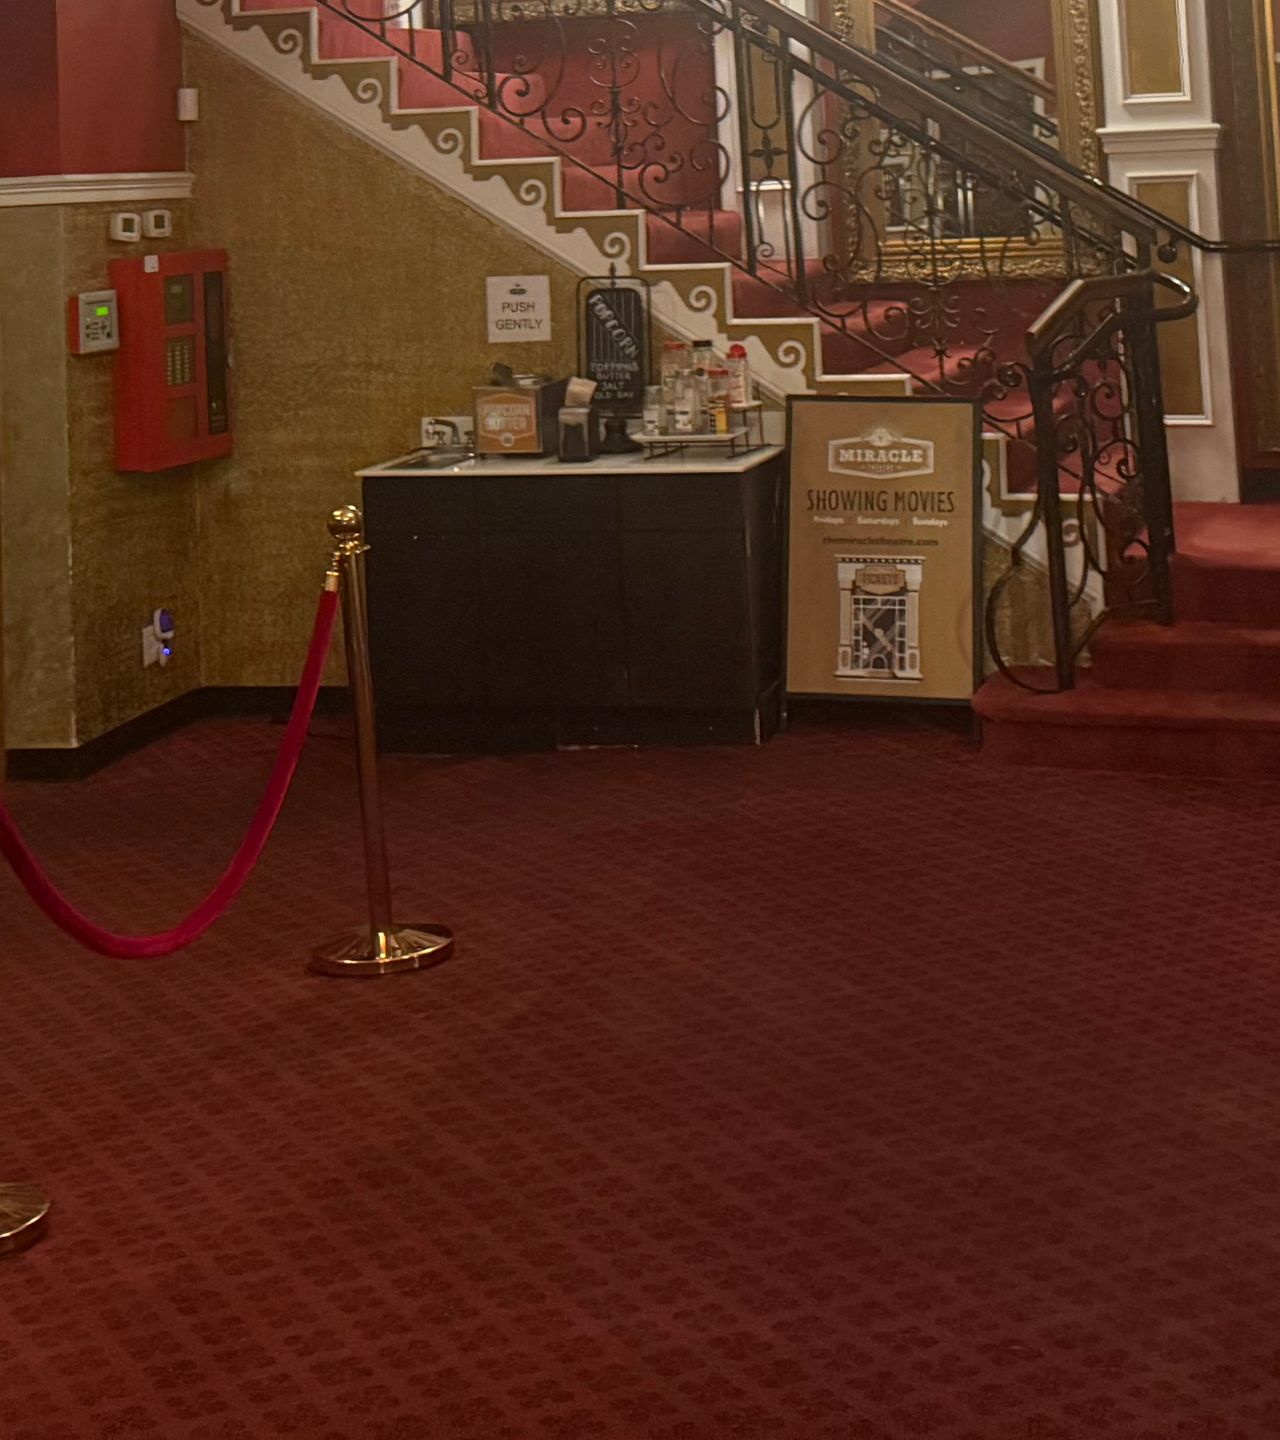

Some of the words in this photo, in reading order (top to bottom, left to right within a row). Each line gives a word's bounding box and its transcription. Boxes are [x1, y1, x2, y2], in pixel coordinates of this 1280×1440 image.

[502, 302, 535, 313] PUSH
[495, 319, 543, 330] GENTLY
[589, 294, 639, 358] POPCORN
[602, 382, 625, 392] SALT
[839, 449, 923, 463] MIRACLE
[807, 489, 888, 511] SHOWING
[894, 491, 955, 513] MOVIES
[857, 516, 900, 526] Saturdays
